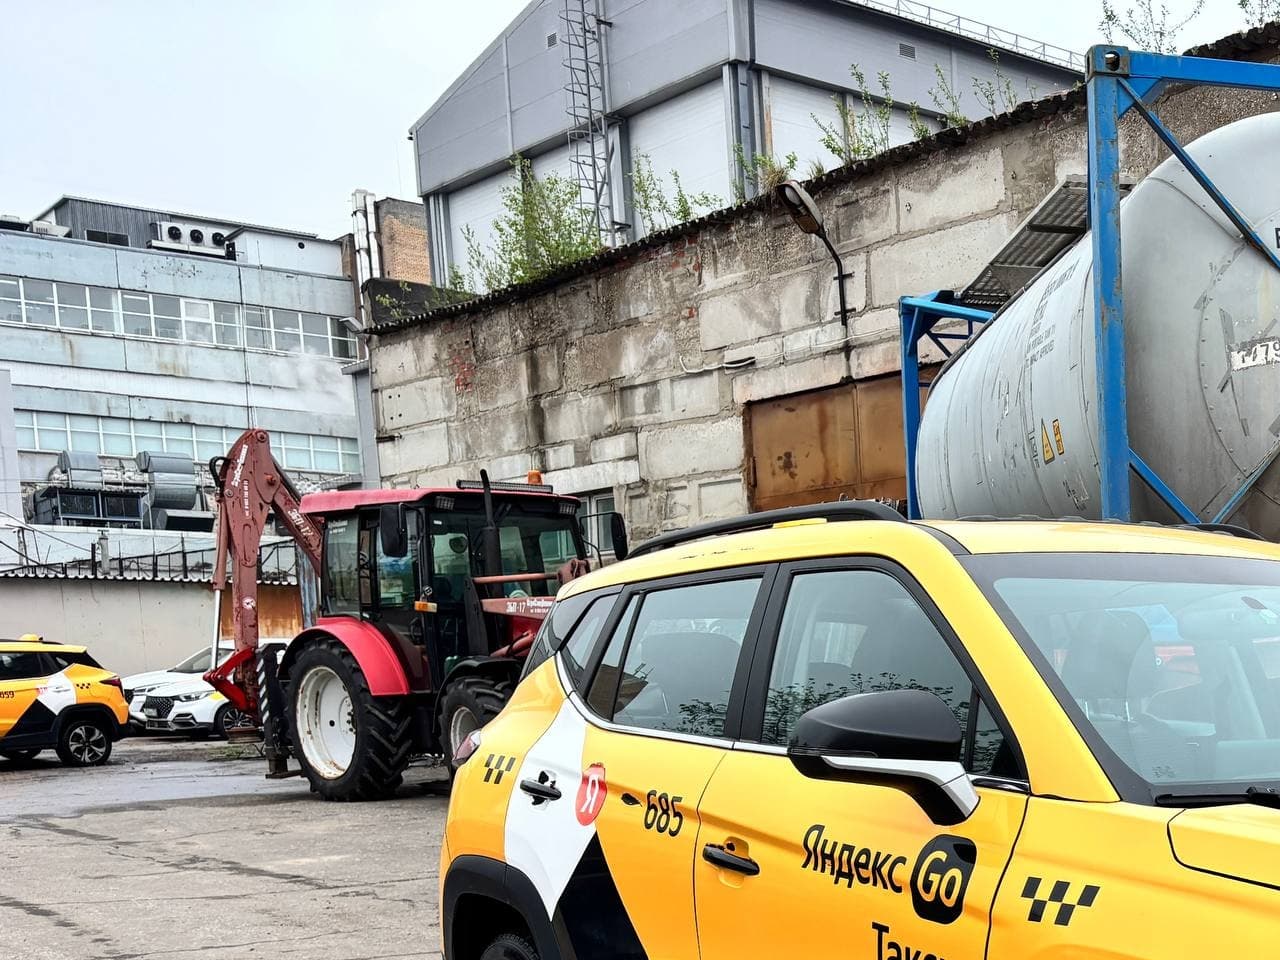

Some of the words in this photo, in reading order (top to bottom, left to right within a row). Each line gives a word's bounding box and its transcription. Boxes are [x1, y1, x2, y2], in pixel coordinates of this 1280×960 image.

[644, 790, 683, 837] 685
[801, 824, 907, 893] Яндекс
[917, 850, 963, 908] Go
